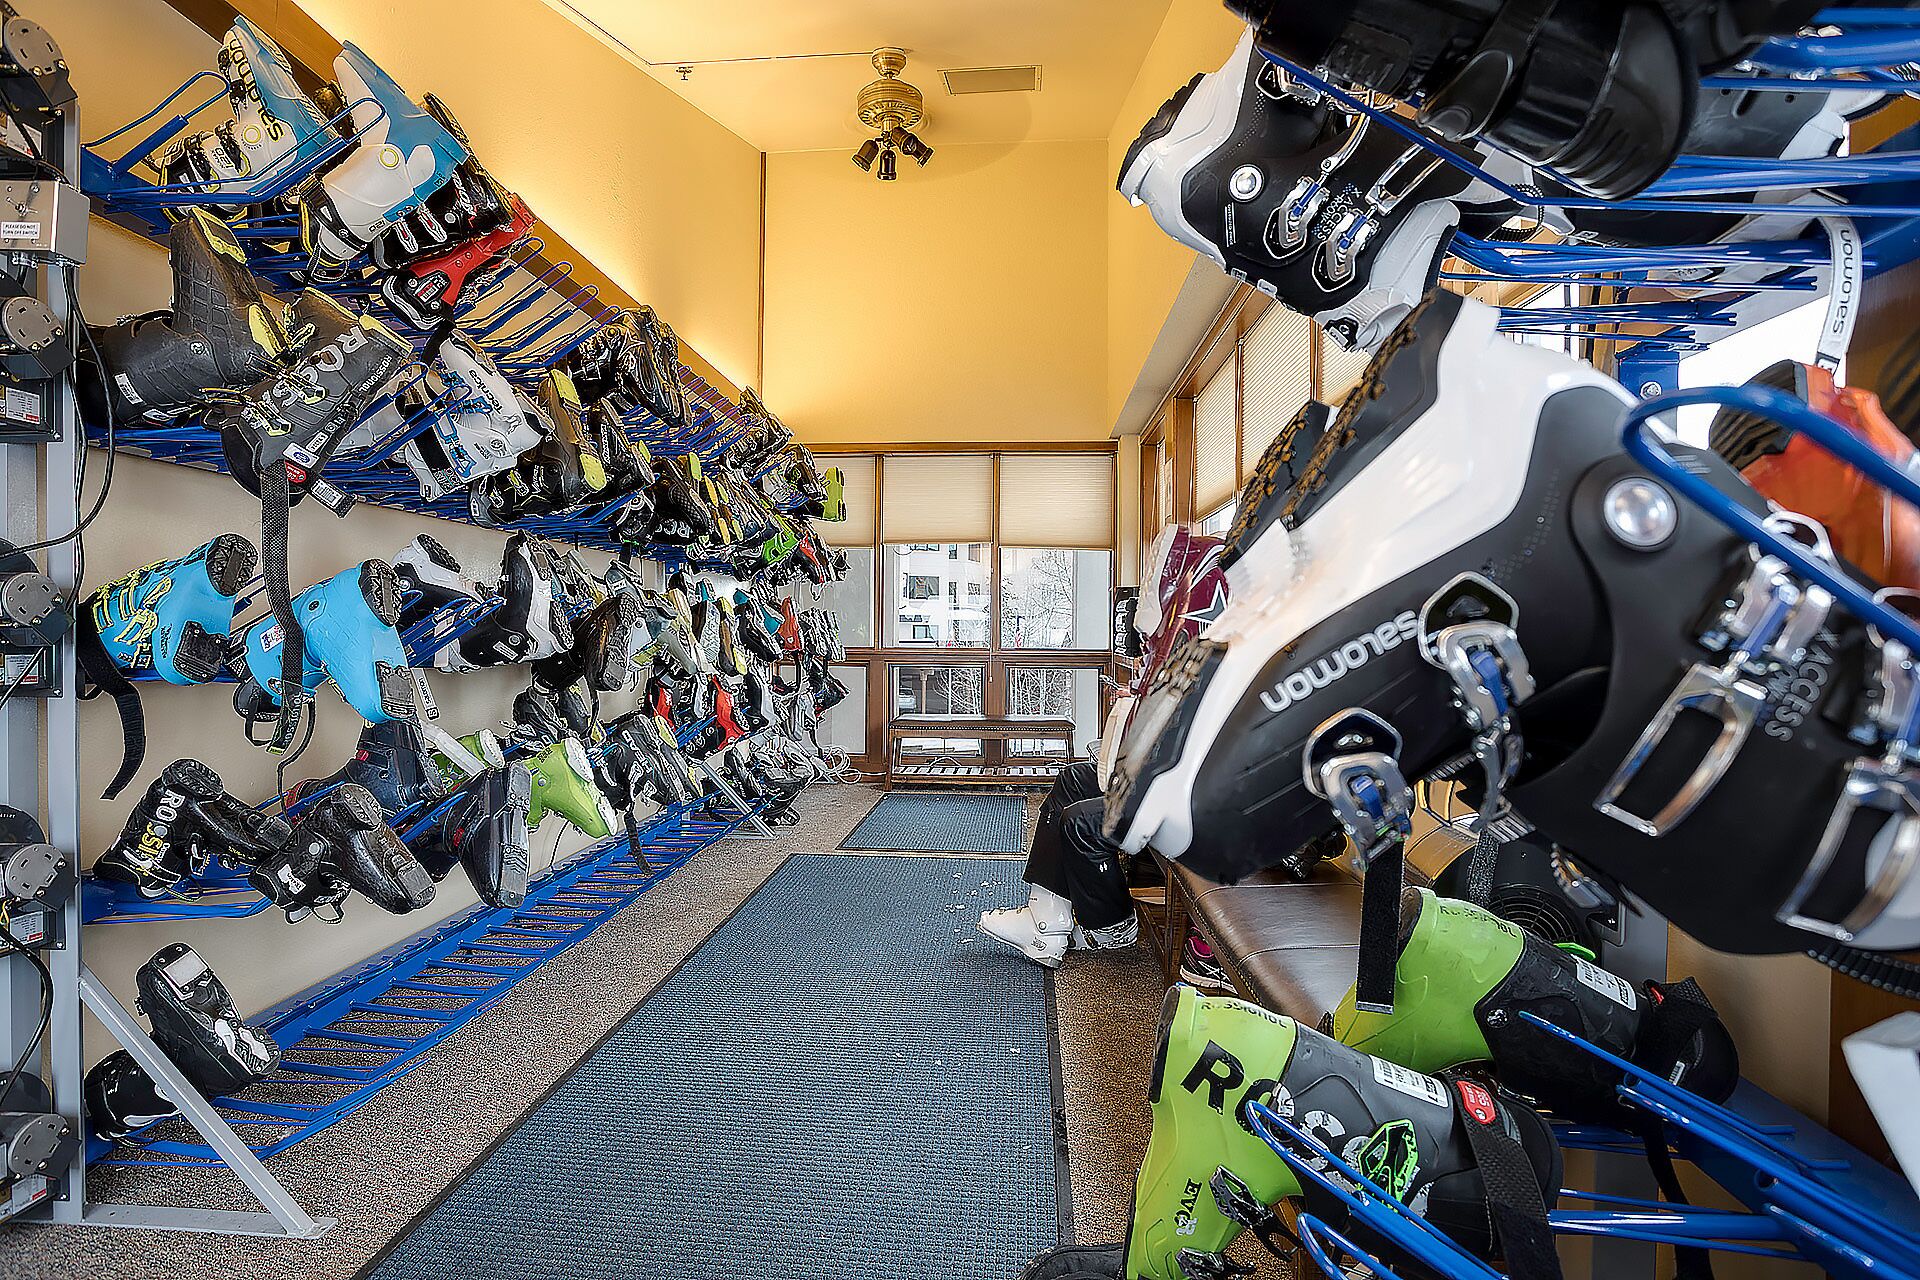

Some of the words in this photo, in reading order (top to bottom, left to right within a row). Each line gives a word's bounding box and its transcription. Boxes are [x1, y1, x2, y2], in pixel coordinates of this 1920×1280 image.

[1351, 187, 1363, 199] X
[1317, 195, 1354, 241] ACCESS
[1832, 228, 1853, 335] salomon
[358, 354, 393, 394] ROSSIGNOL
[468, 369, 502, 415] Tecnica
[1259, 609, 1419, 714] salomon
[1764, 644, 1834, 741] ACCESS
